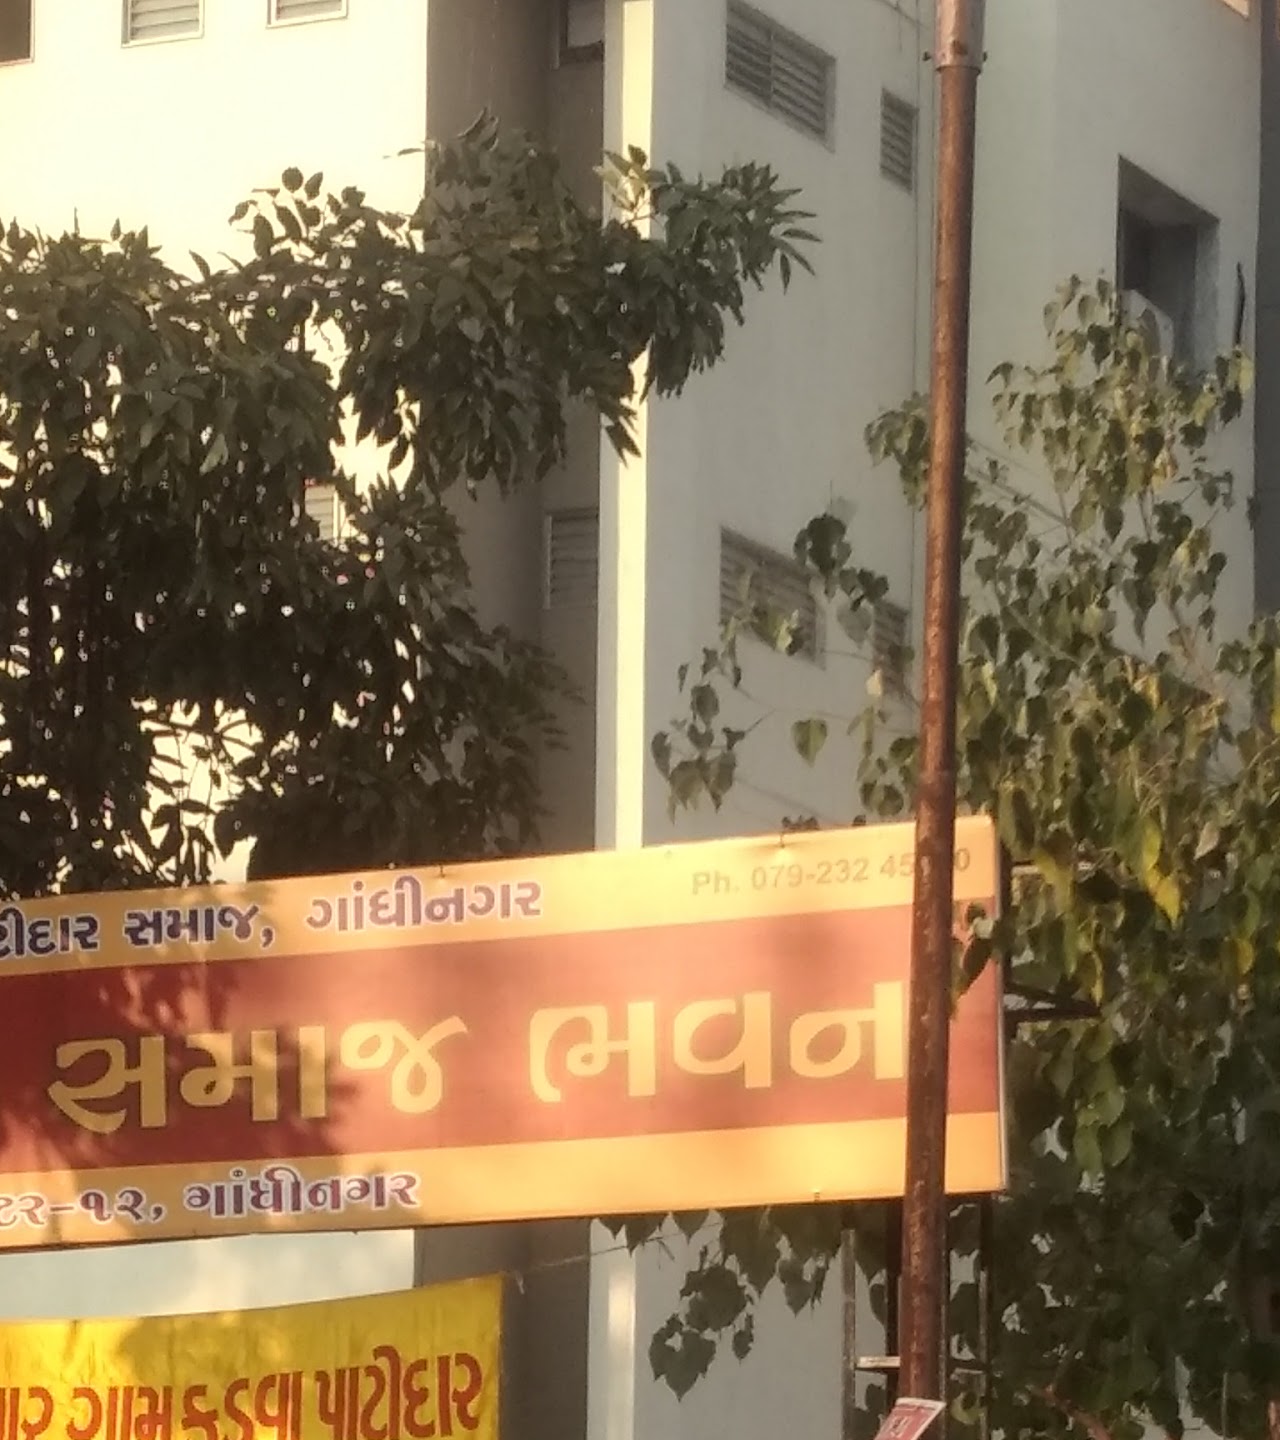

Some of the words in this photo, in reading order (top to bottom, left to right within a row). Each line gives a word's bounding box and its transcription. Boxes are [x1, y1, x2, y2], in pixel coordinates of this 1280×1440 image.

[691, 871, 739, 895] Ph.
[751, 855, 870, 891] 079-232
[879, 847, 971, 878] 450
[123, 903, 275, 953] સમાજ,
[306, 874, 543, 935] ગાંધીનગર
[47, 1016, 468, 1135] સમાજ
[528, 981, 908, 1104] ભવન
[183, 1166, 421, 1220] ગાંધીનગર
